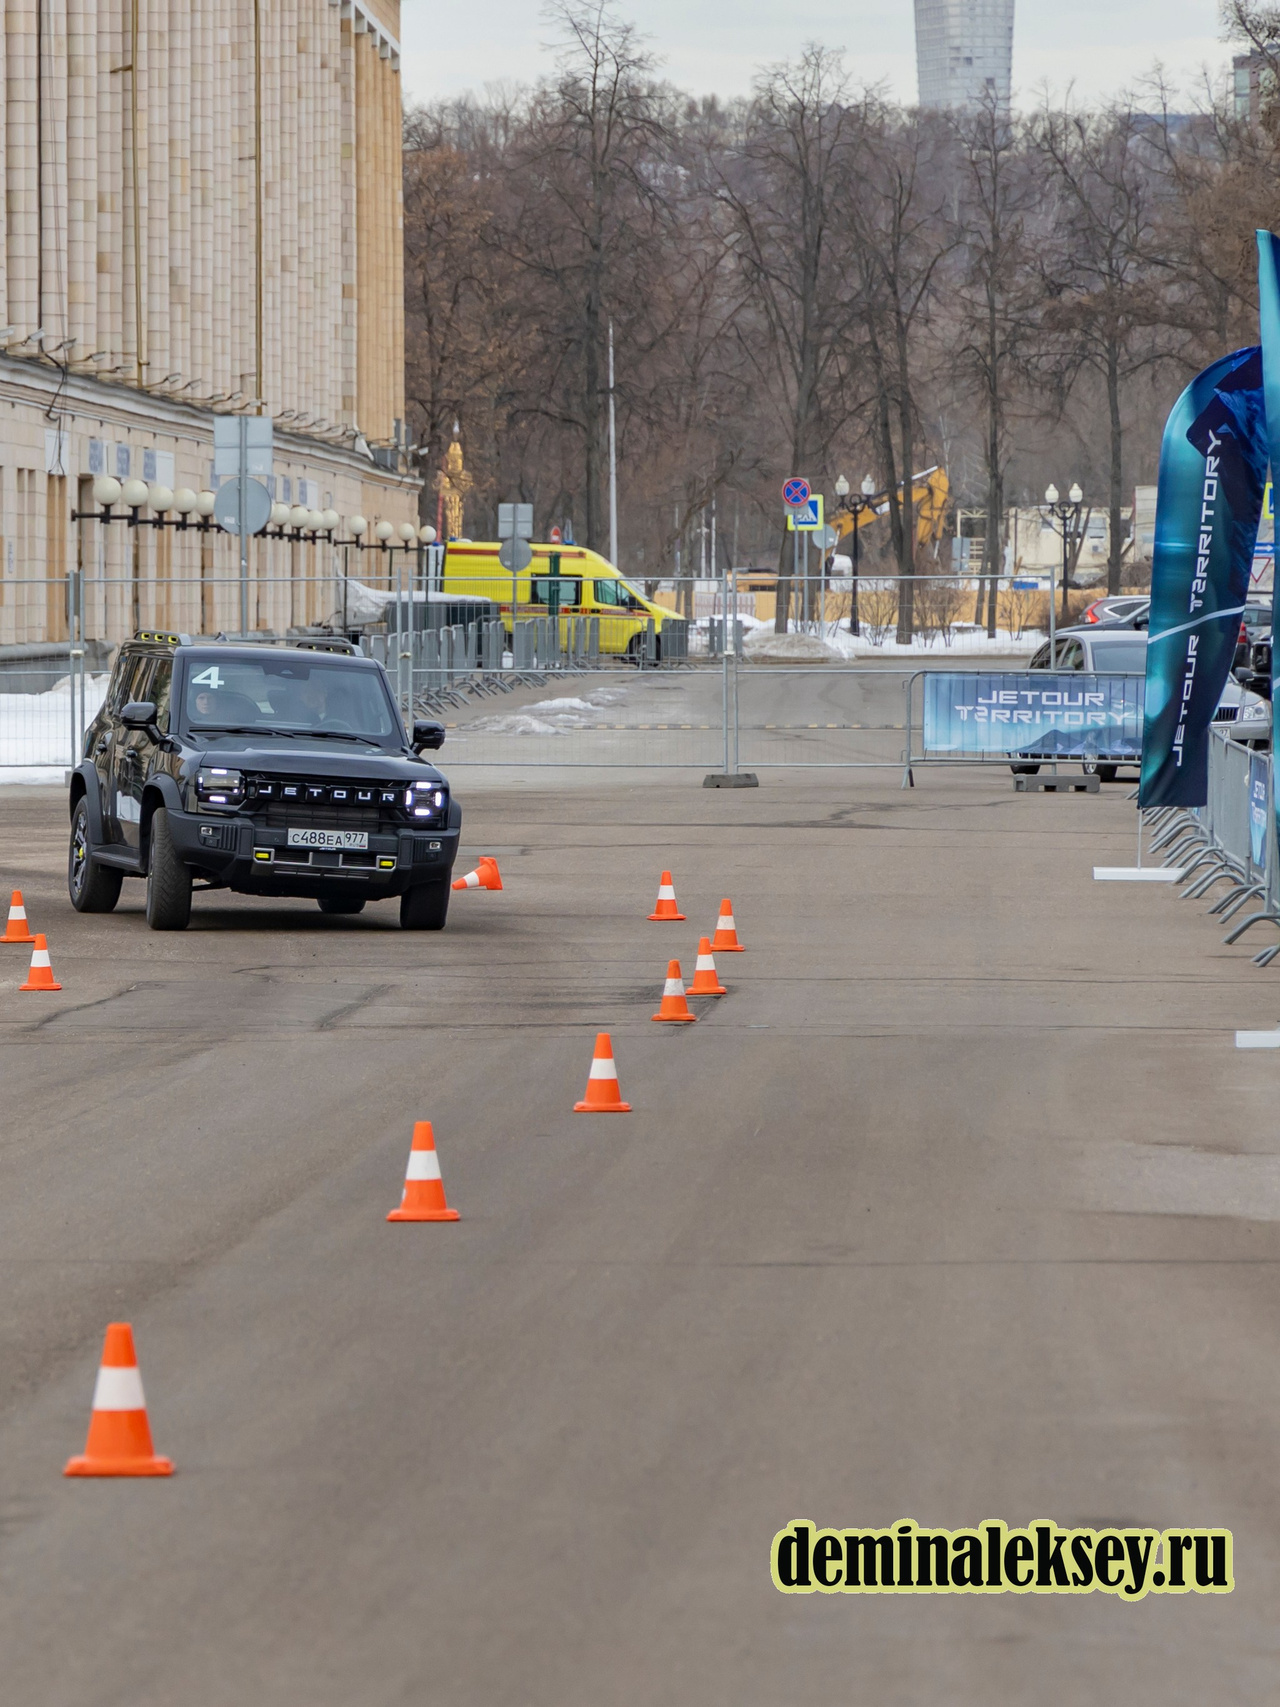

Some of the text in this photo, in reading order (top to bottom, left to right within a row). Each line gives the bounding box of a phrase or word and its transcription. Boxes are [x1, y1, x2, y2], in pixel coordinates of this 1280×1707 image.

[191, 665, 224, 689] 4
[977, 689, 1106, 707] JETOUR
[1172, 634, 1201, 767] JETOUR
[259, 785, 395, 801] JETOUR
[345, 832, 365, 843] 977
